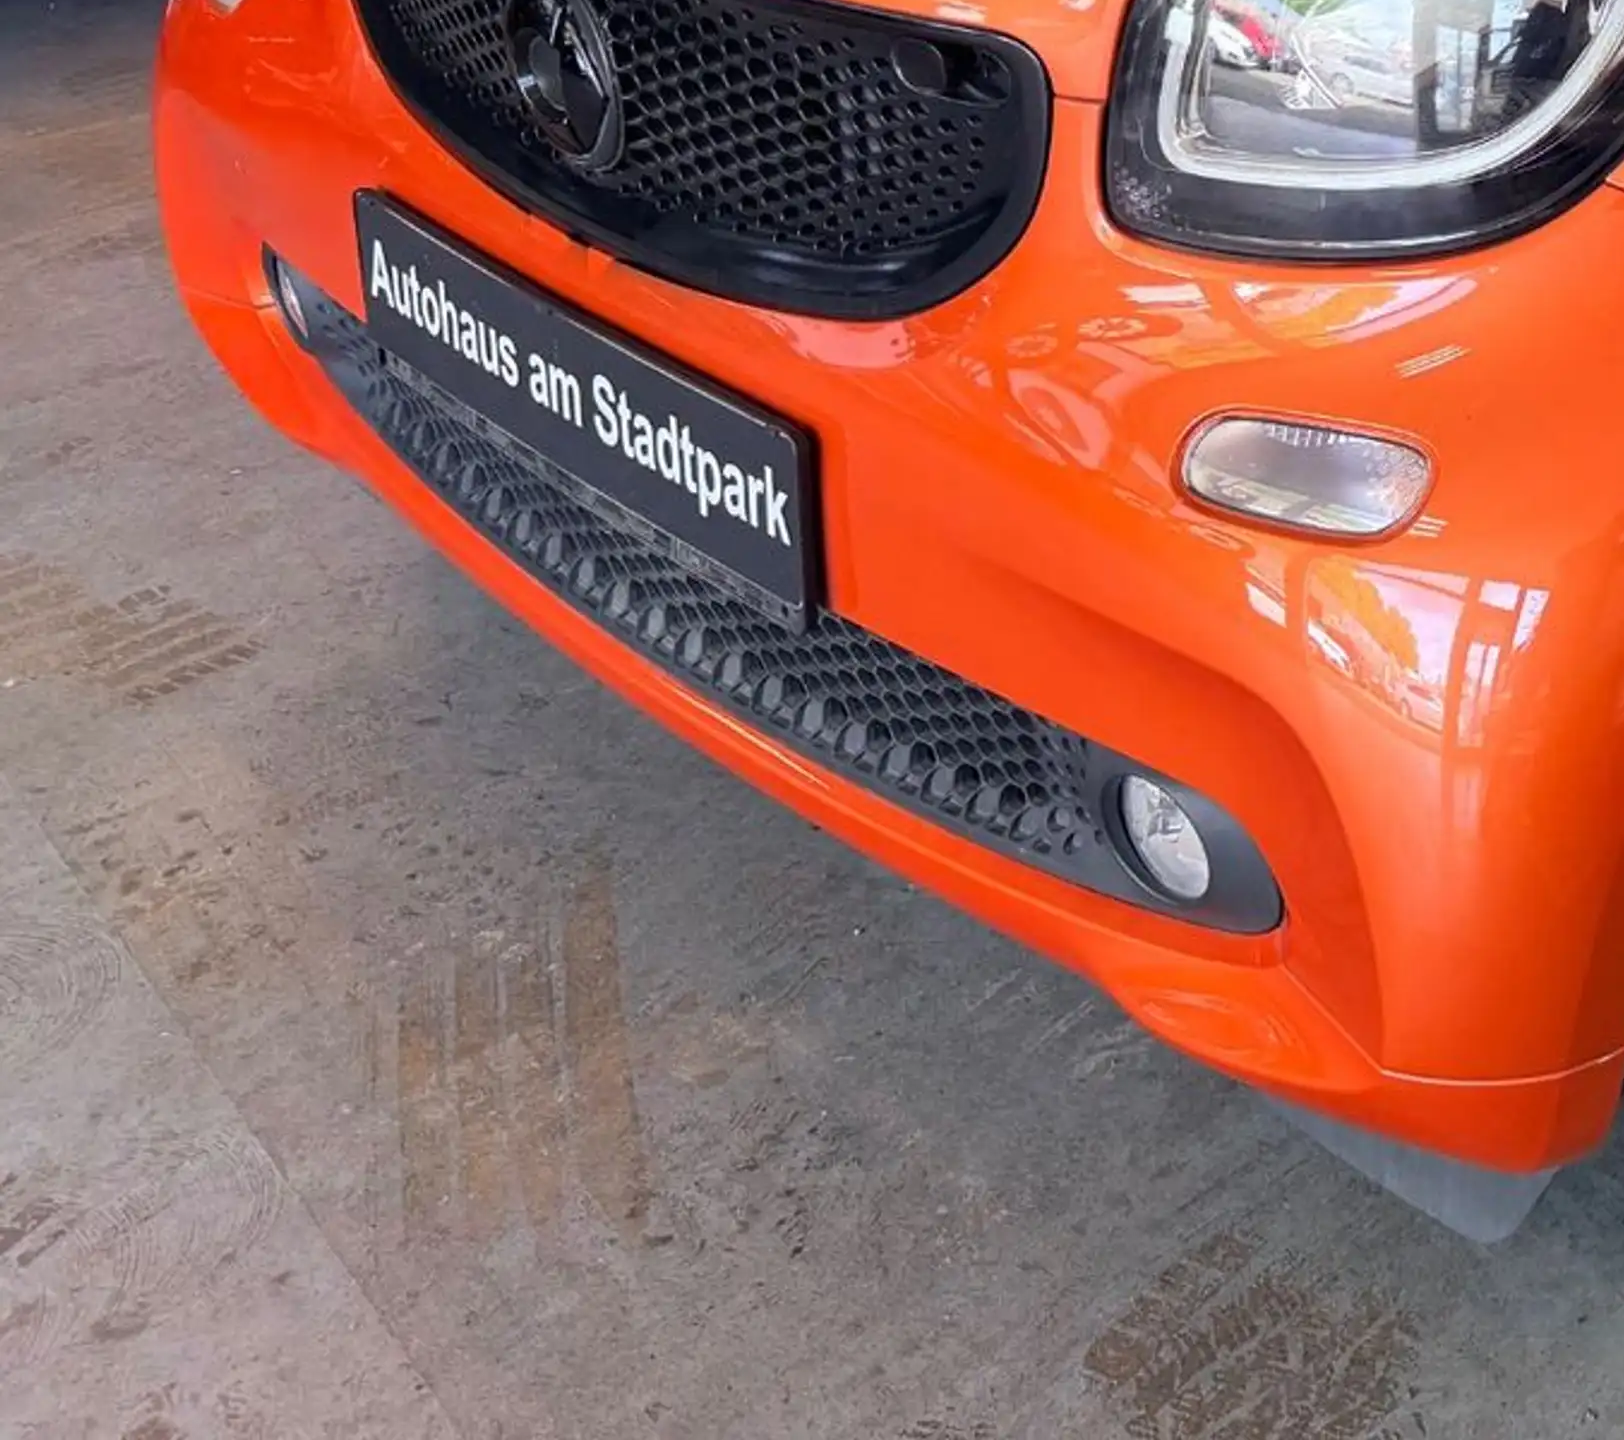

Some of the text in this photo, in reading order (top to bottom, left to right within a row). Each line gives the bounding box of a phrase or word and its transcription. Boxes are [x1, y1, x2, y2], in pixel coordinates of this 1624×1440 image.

[370, 239, 792, 547] Autohaus am Stadtpark
